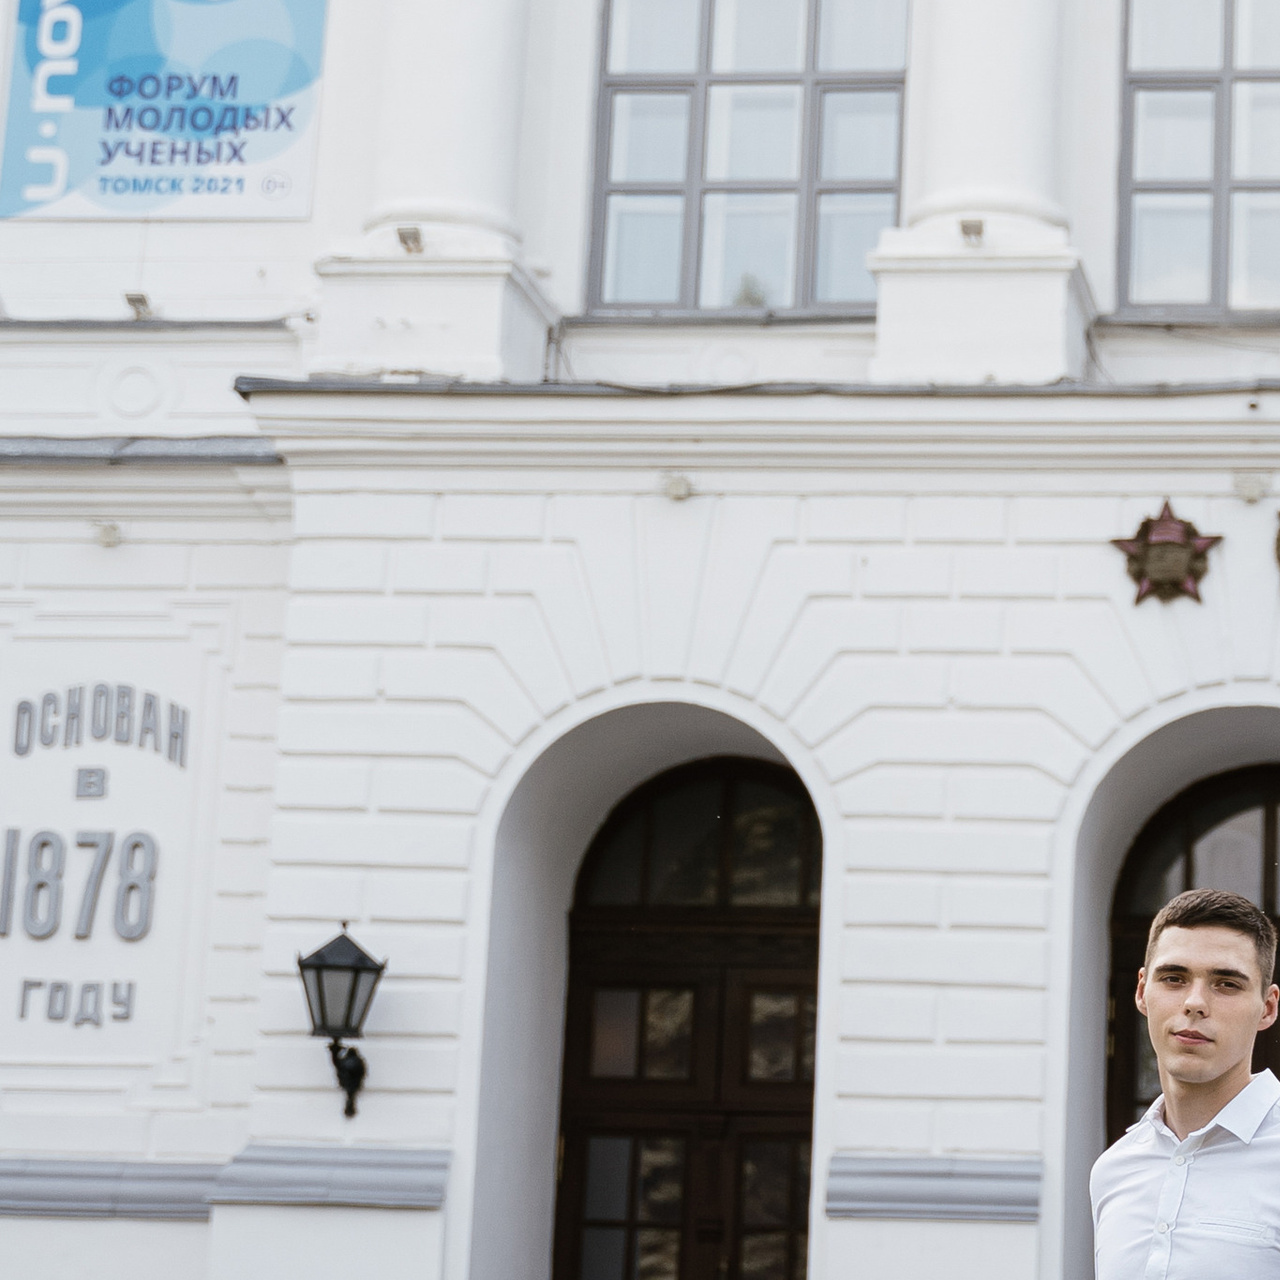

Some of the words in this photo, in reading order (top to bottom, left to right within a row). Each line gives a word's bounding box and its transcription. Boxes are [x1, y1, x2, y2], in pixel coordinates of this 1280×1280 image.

[106, 74, 239, 99] ФОРУМ
[103, 106, 295, 138] МОЛОДЫХ
[100, 141, 247, 166] УЧЕНЫХ
[99, 178, 183, 194] ТОМСК
[191, 177, 245, 195] 2021
[14, 683, 188, 767] ОСНОВАН
[0, 829, 157, 941] 1878
